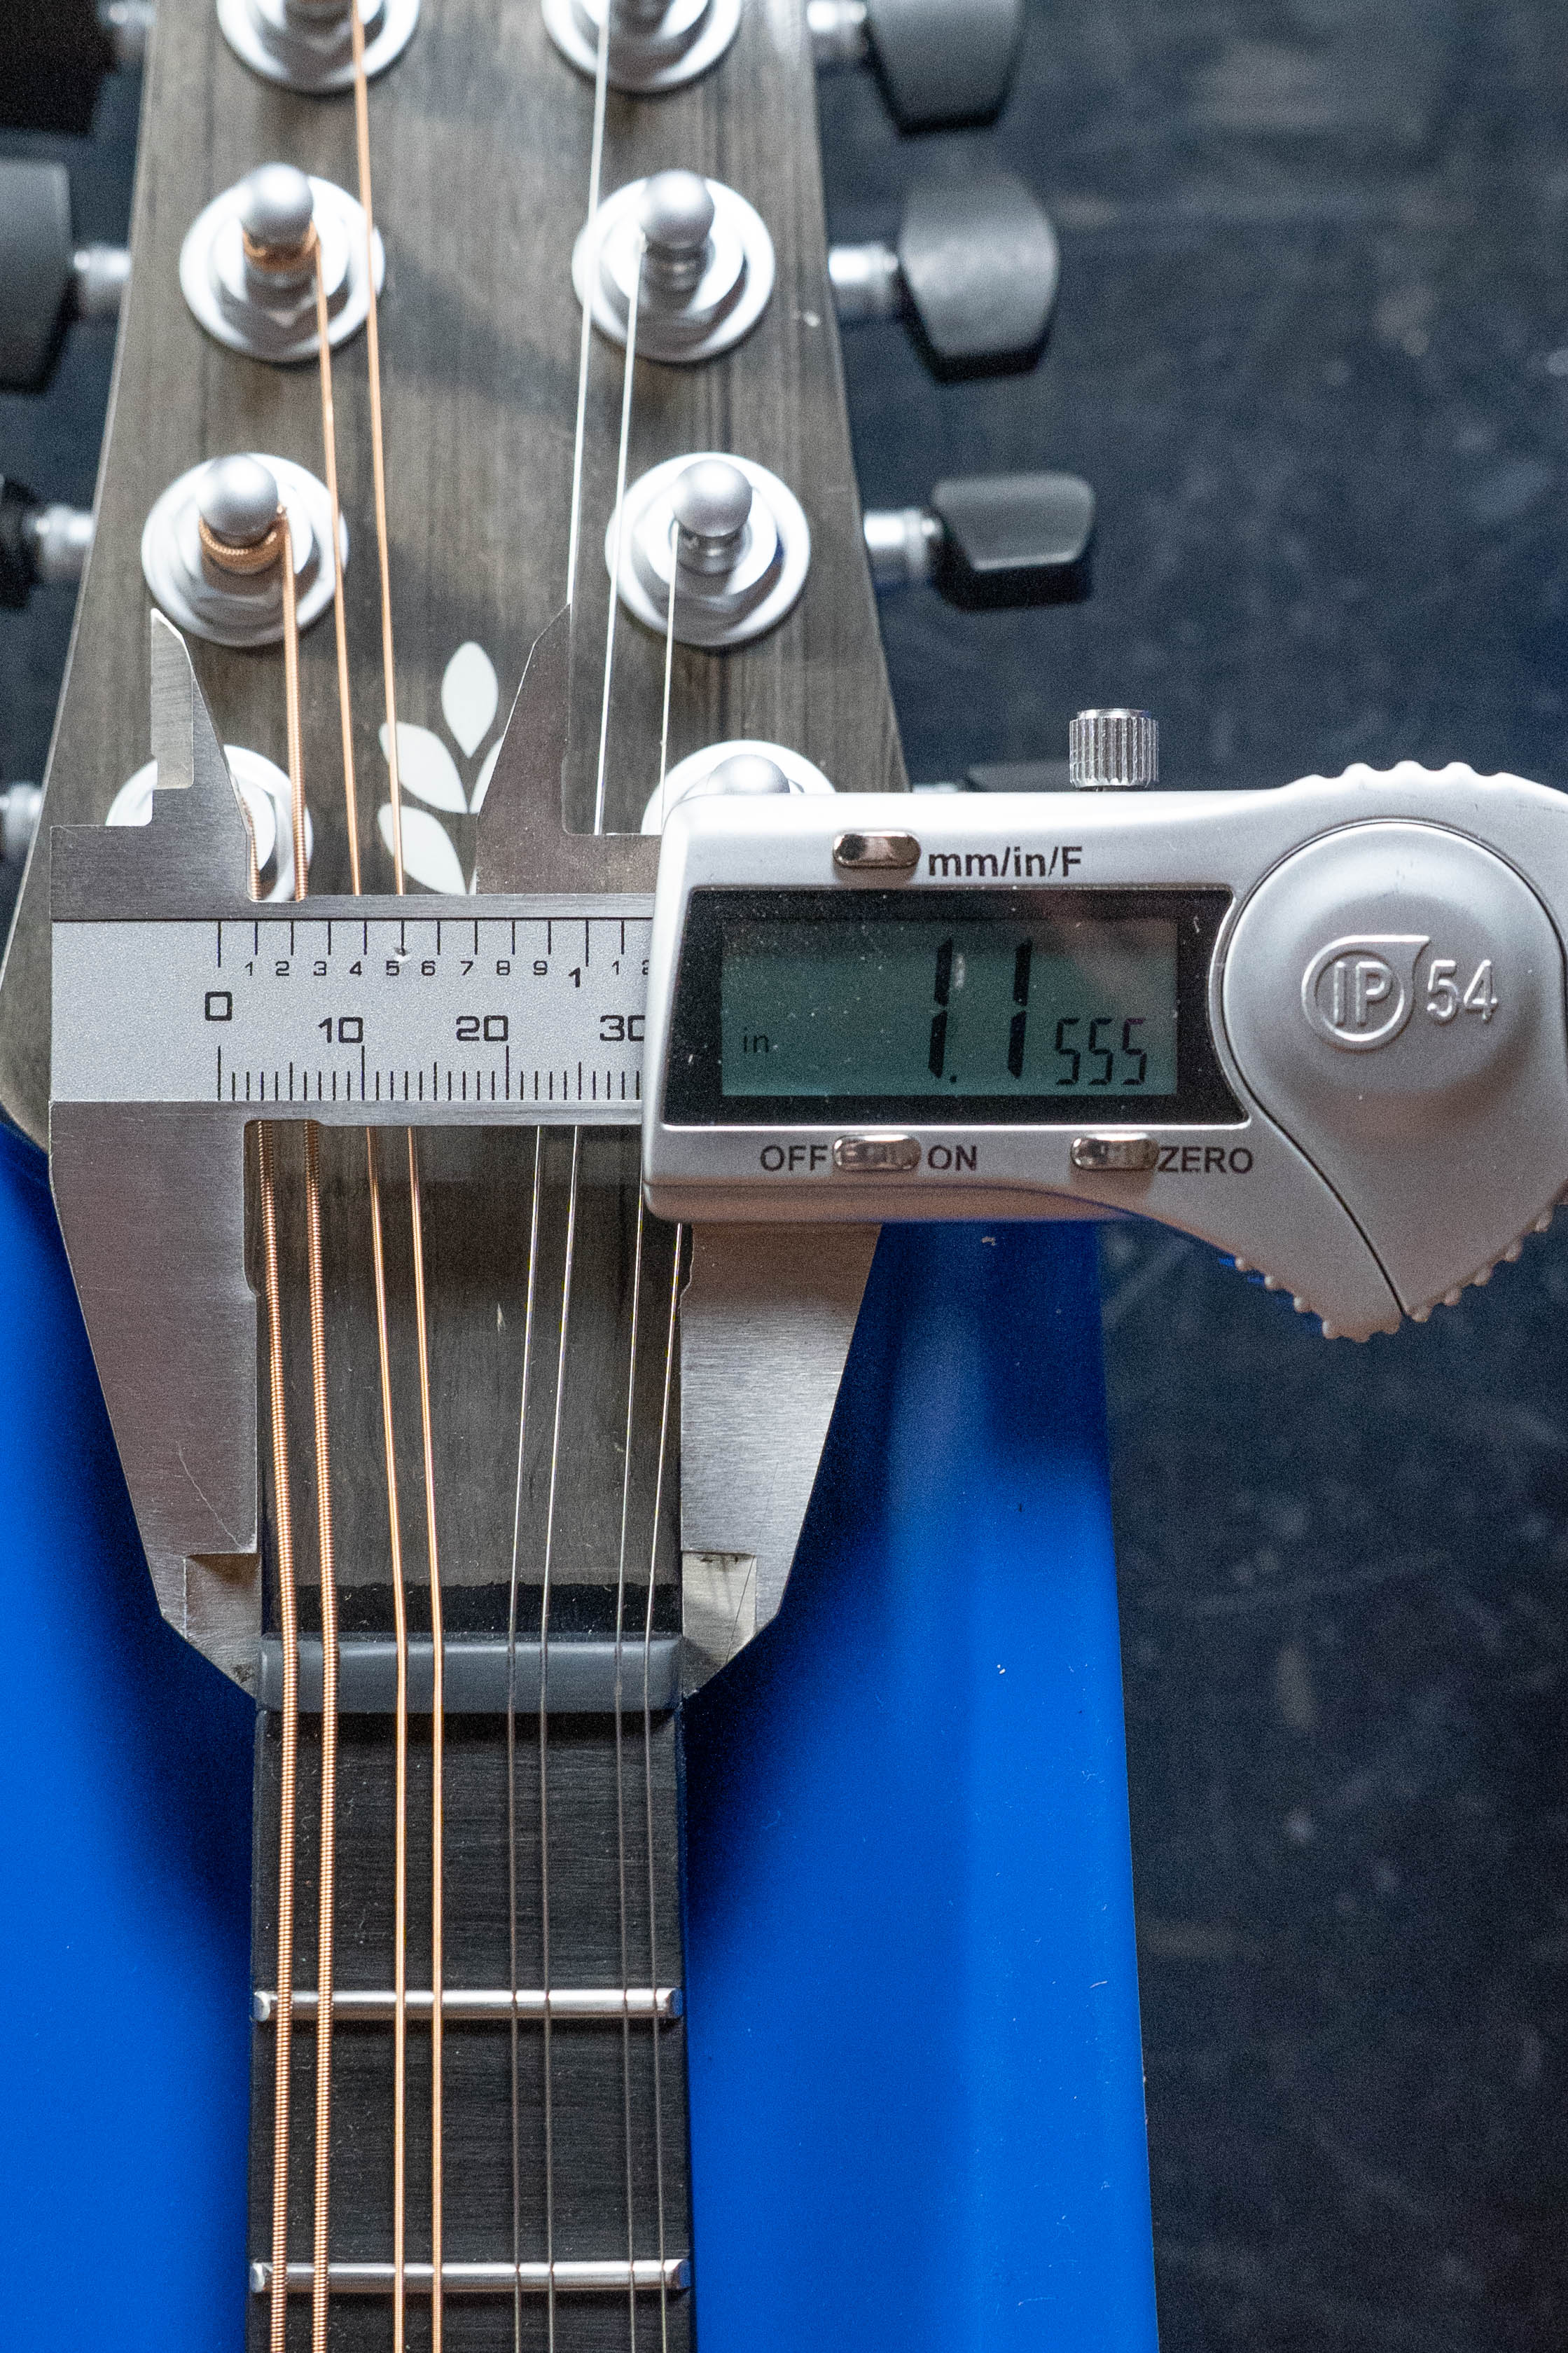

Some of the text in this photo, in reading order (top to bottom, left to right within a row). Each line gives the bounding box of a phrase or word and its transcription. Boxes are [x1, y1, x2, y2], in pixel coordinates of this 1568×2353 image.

[929, 846, 1082, 876] mm/in/F
[244, 960, 254, 977] 1
[275, 960, 290, 977] 2
[313, 960, 327, 977] 3
[349, 960, 363, 977] 4
[386, 960, 400, 977] 5
[421, 960, 436, 977] 6
[460, 960, 474, 977] 7
[496, 960, 511, 977] 8
[533, 960, 548, 977] 9
[568, 967, 581, 988] 1
[611, 960, 619, 975] 1
[204, 991, 233, 1021] 0
[1333, 958, 1499, 1027] IP 54
[318, 1016, 363, 1044] 10
[456, 1015, 508, 1042] 20
[742, 1027, 770, 1053] in
[760, 1145, 977, 1172] OFF ON
[1156, 1146, 1254, 1174] ZERO
